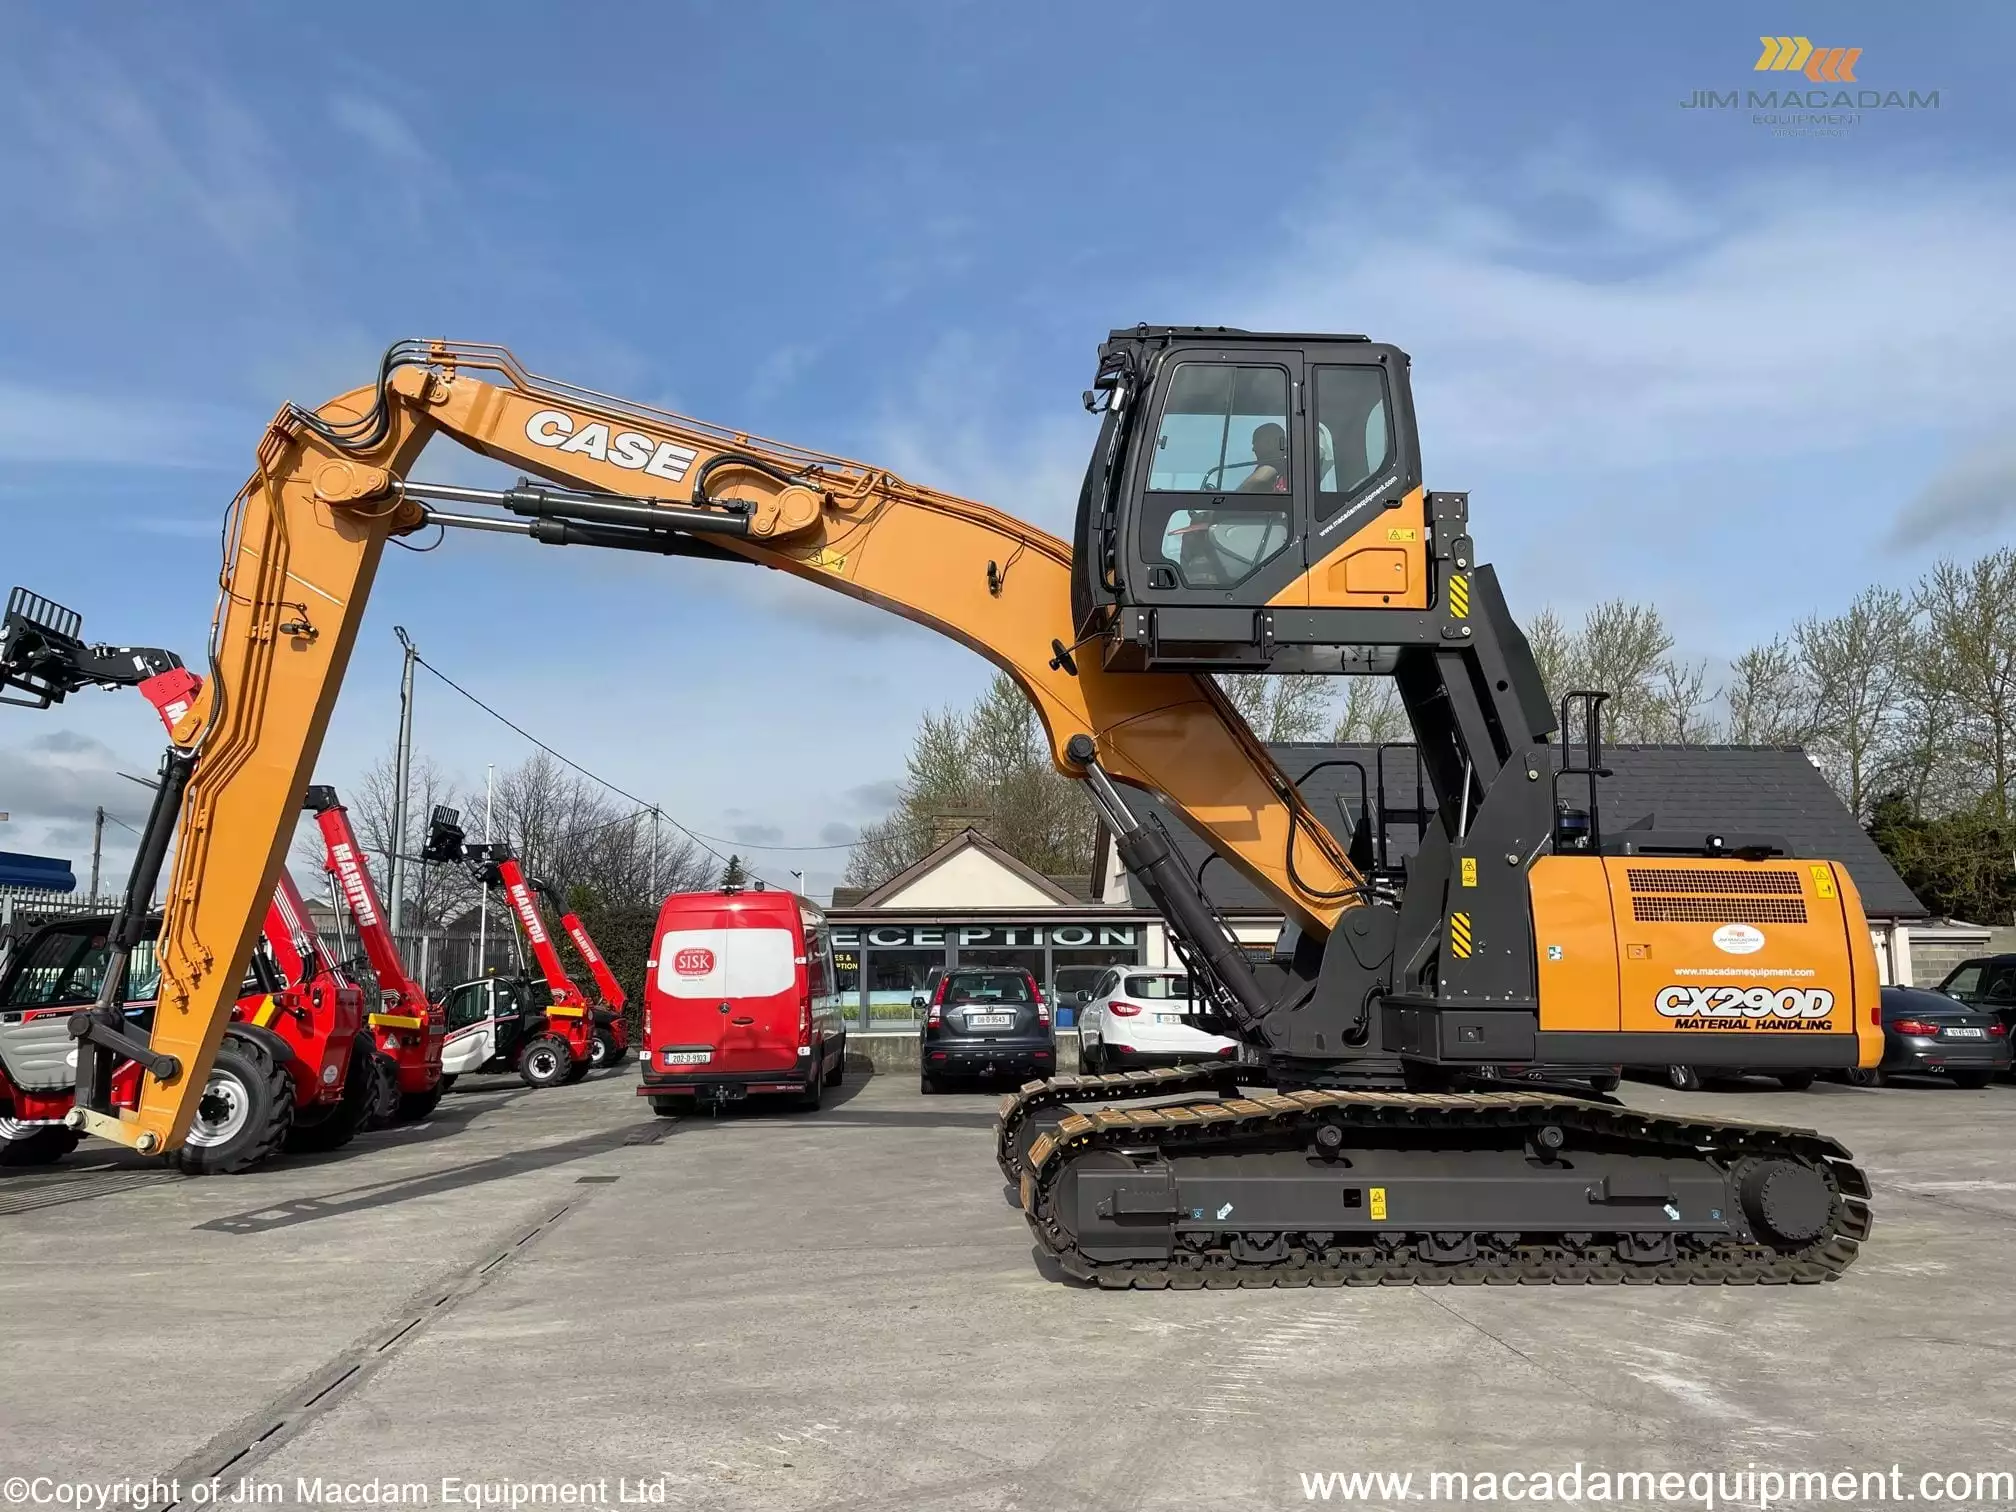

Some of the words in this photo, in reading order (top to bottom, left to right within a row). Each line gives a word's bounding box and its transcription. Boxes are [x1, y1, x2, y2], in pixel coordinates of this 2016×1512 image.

[525, 410, 699, 483] CASE
[1319, 475, 1397, 537] www.macadamequipment.com
[332, 843, 377, 927] MANITOU
[510, 883, 546, 944] MANITOU
[571, 928, 598, 963] MANITOU
[830, 926, 1136, 946] ECEPTION
[679, 954, 710, 969] SISK
[1674, 967, 1815, 977] www.macadamequipment.com
[1655, 985, 1835, 1019] CX290D
[1675, 1019, 1751, 1030] MATERIAL
[1755, 1019, 1832, 1031] HANDLING
